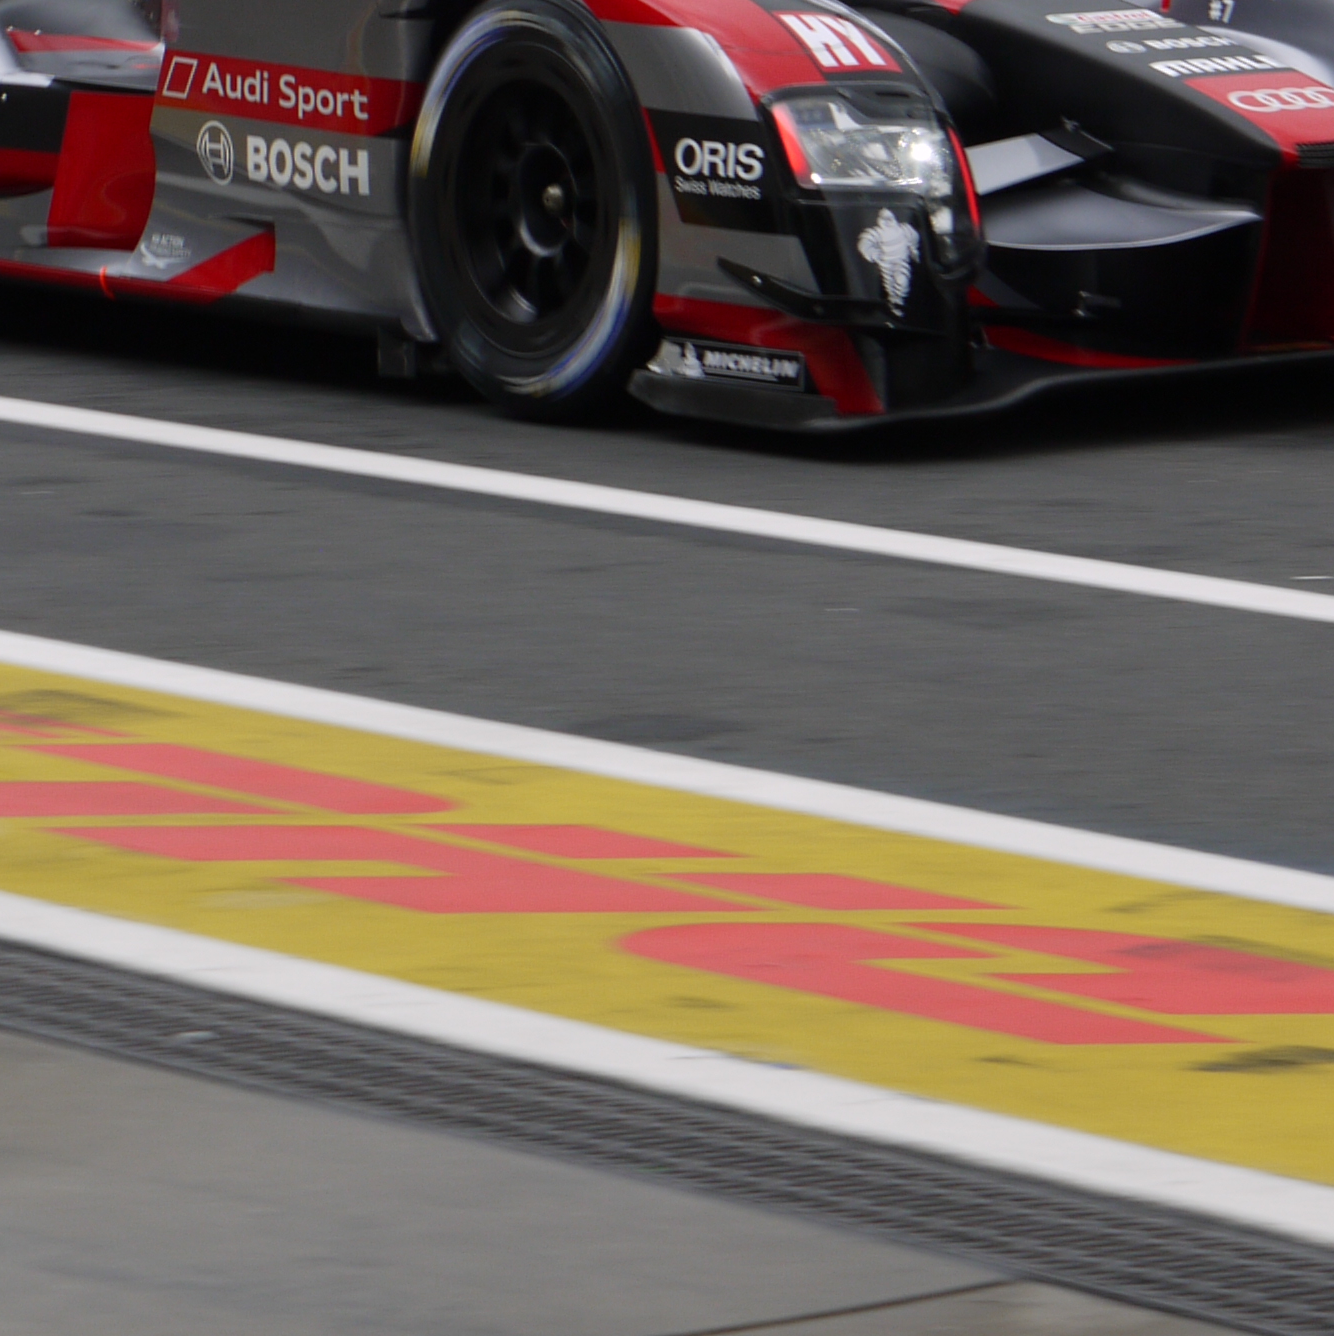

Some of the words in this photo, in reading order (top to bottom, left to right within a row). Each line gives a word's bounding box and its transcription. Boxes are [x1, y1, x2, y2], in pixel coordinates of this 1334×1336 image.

[778, 14, 888, 68] HY
[202, 63, 269, 104] Audi
[278, 74, 369, 121] Sport
[246, 135, 370, 196] BOSCH
[674, 137, 765, 182] ORIS
[703, 350, 799, 378] MICHELIN
